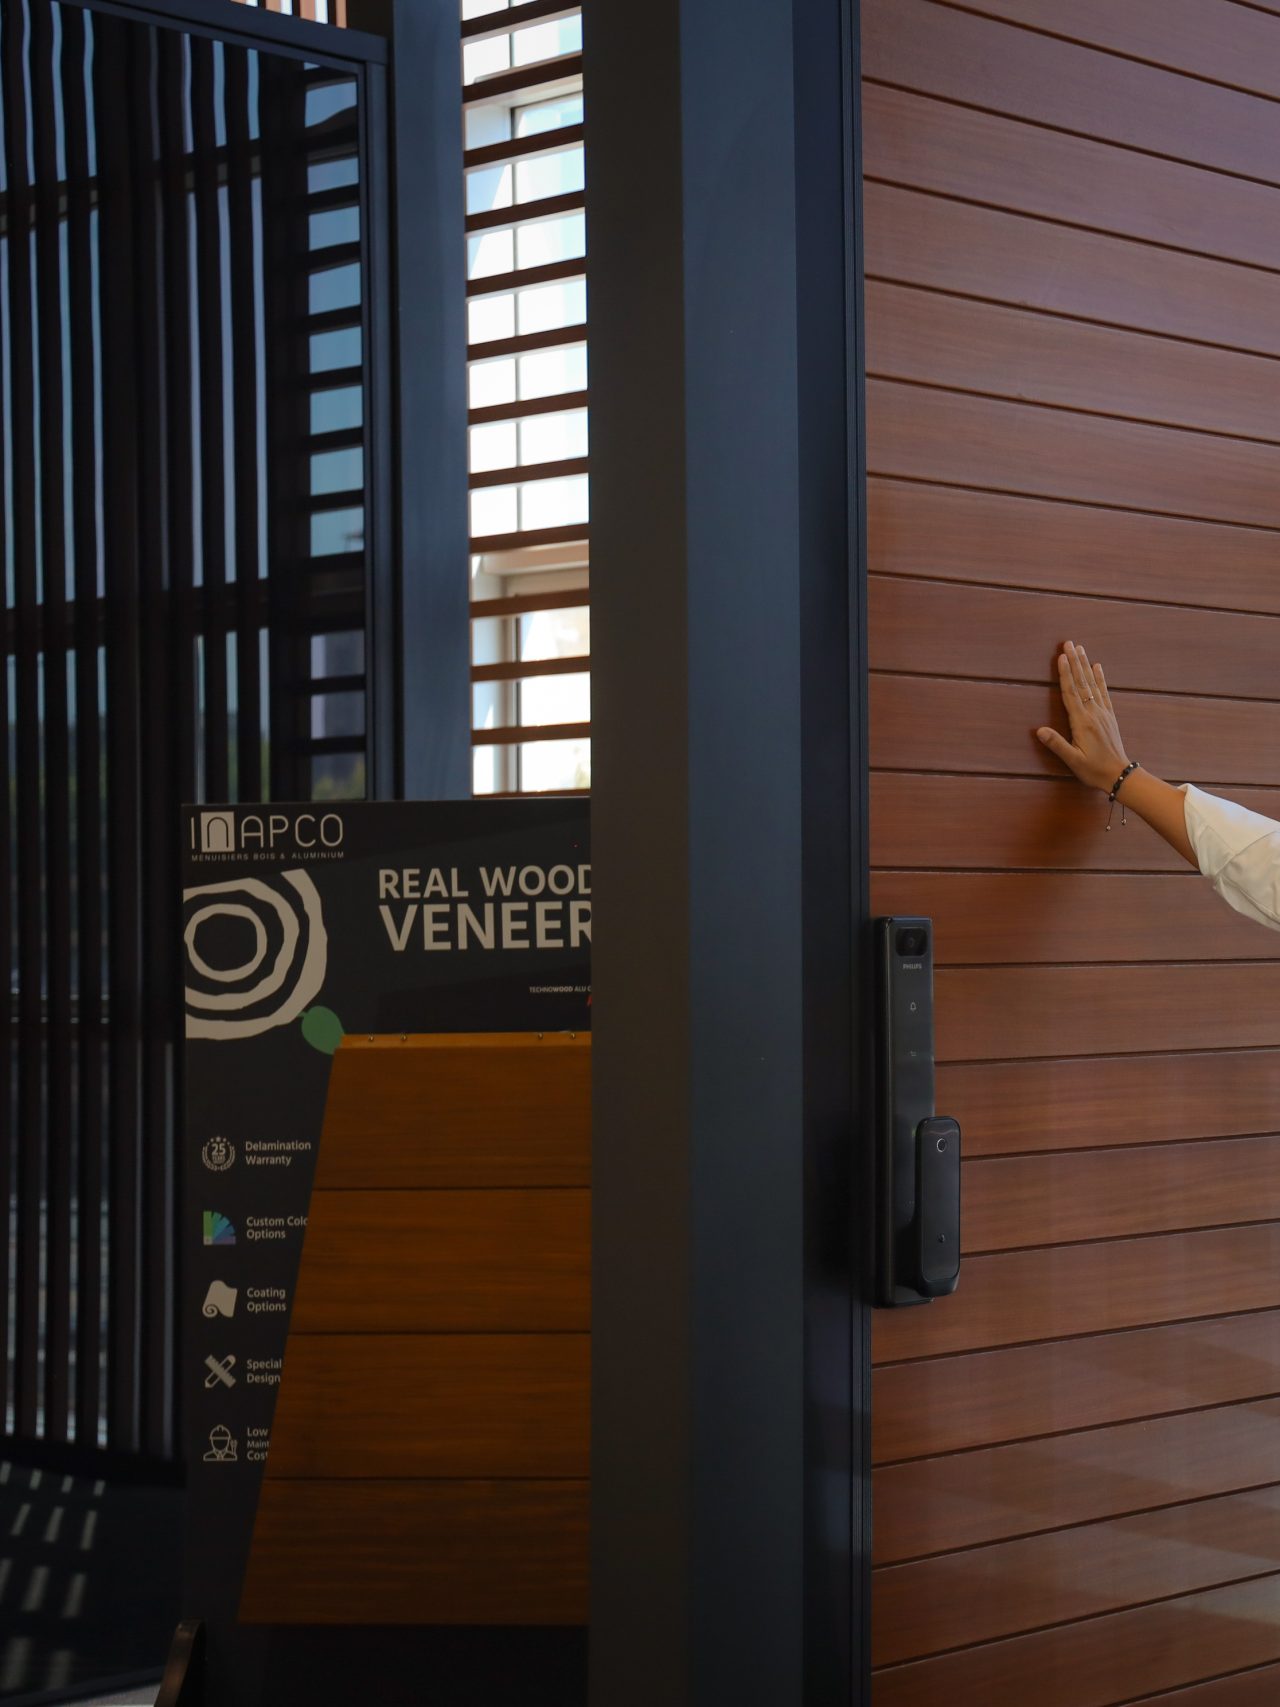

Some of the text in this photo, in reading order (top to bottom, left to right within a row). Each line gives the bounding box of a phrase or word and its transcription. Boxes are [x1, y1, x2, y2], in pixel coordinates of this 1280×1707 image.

[291, 851, 345, 859] ALUMINIUM
[378, 867, 469, 899] REAL
[378, 900, 592, 951] VENEER
[211, 1143, 226, 1155] 25
[245, 1140, 311, 1151] Delamination
[245, 1154, 292, 1166] Warranty
[246, 1216, 285, 1227] Custom
[246, 1228, 286, 1240] Options
[246, 1287, 286, 1299] Coating
[246, 1301, 287, 1313] Options
[246, 1358, 282, 1370] Special
[246, 1372, 281, 1385] Design
[246, 1427, 268, 1437] Low
